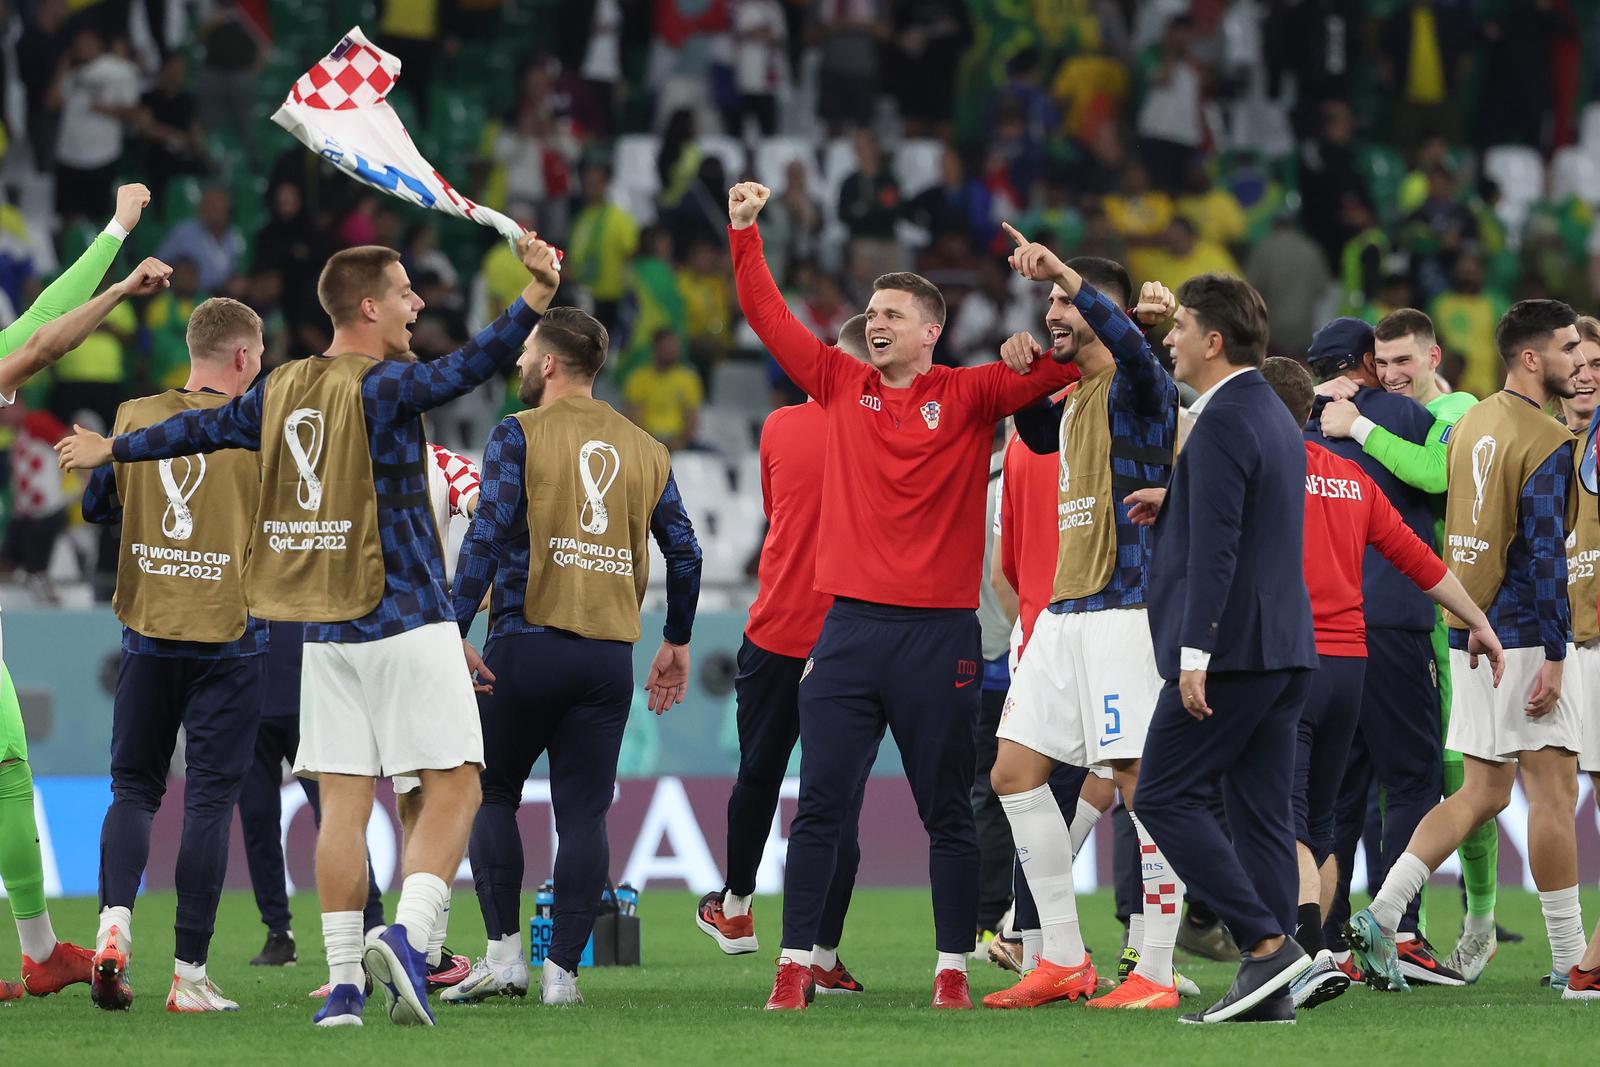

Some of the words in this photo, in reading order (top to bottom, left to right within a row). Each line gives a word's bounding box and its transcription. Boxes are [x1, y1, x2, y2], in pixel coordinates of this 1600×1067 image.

[1077, 496, 1096, 510] CUP
[328, 520, 352, 533] CUP
[149, 546, 202, 562] WORLD
[203, 552, 231, 565] CUP
[549, 537, 577, 549] FIFA
[617, 548, 632, 561] CU
[553, 550, 633, 576] Qatar2022
[1104, 694, 1120, 734] 5
